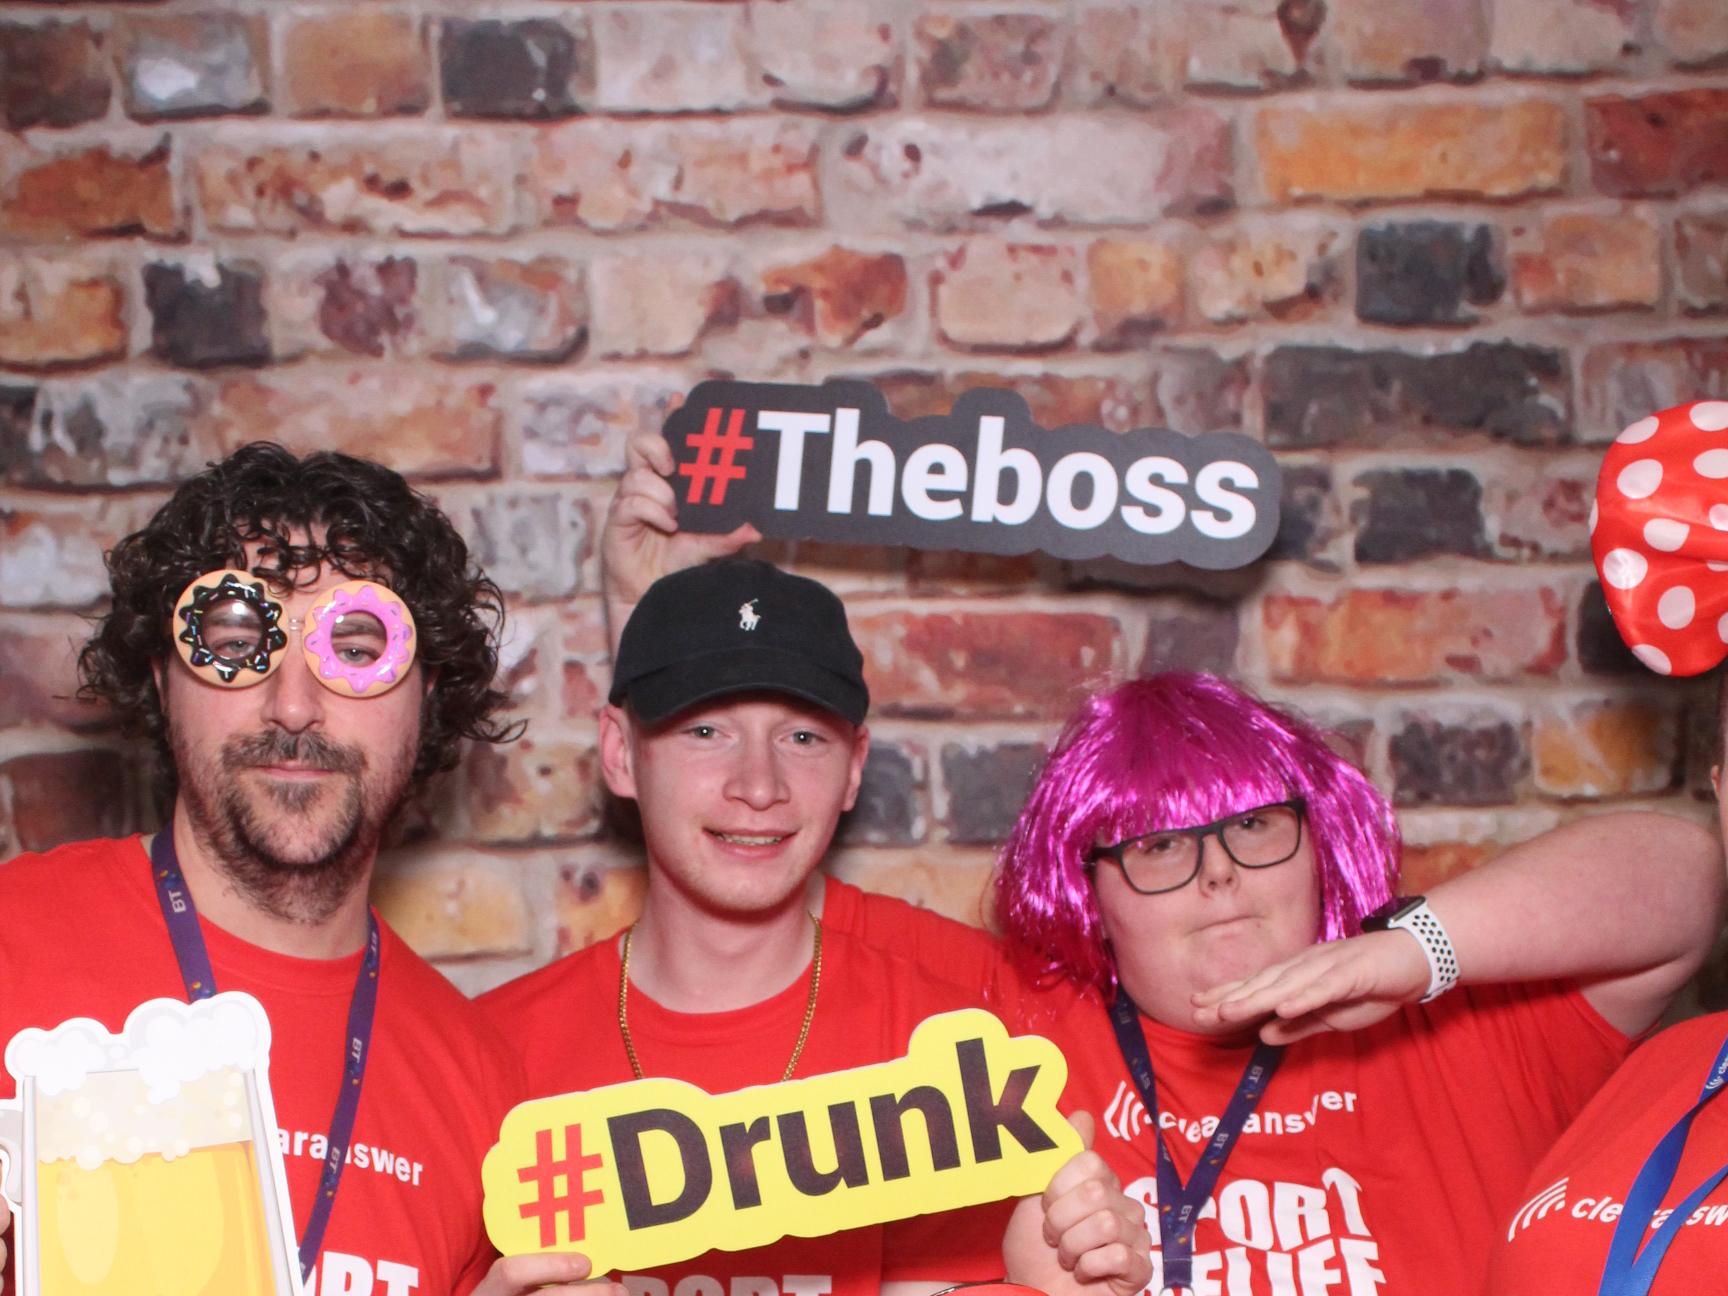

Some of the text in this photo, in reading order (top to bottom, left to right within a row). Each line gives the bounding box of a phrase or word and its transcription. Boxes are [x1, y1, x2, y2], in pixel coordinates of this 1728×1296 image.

[678, 406, 1260, 540] #Theboss
[168, 889, 187, 914] BT
[352, 1036, 363, 1063] BT
[516, 1037, 1059, 1248] #Drunk
[329, 1146, 341, 1174] BT
